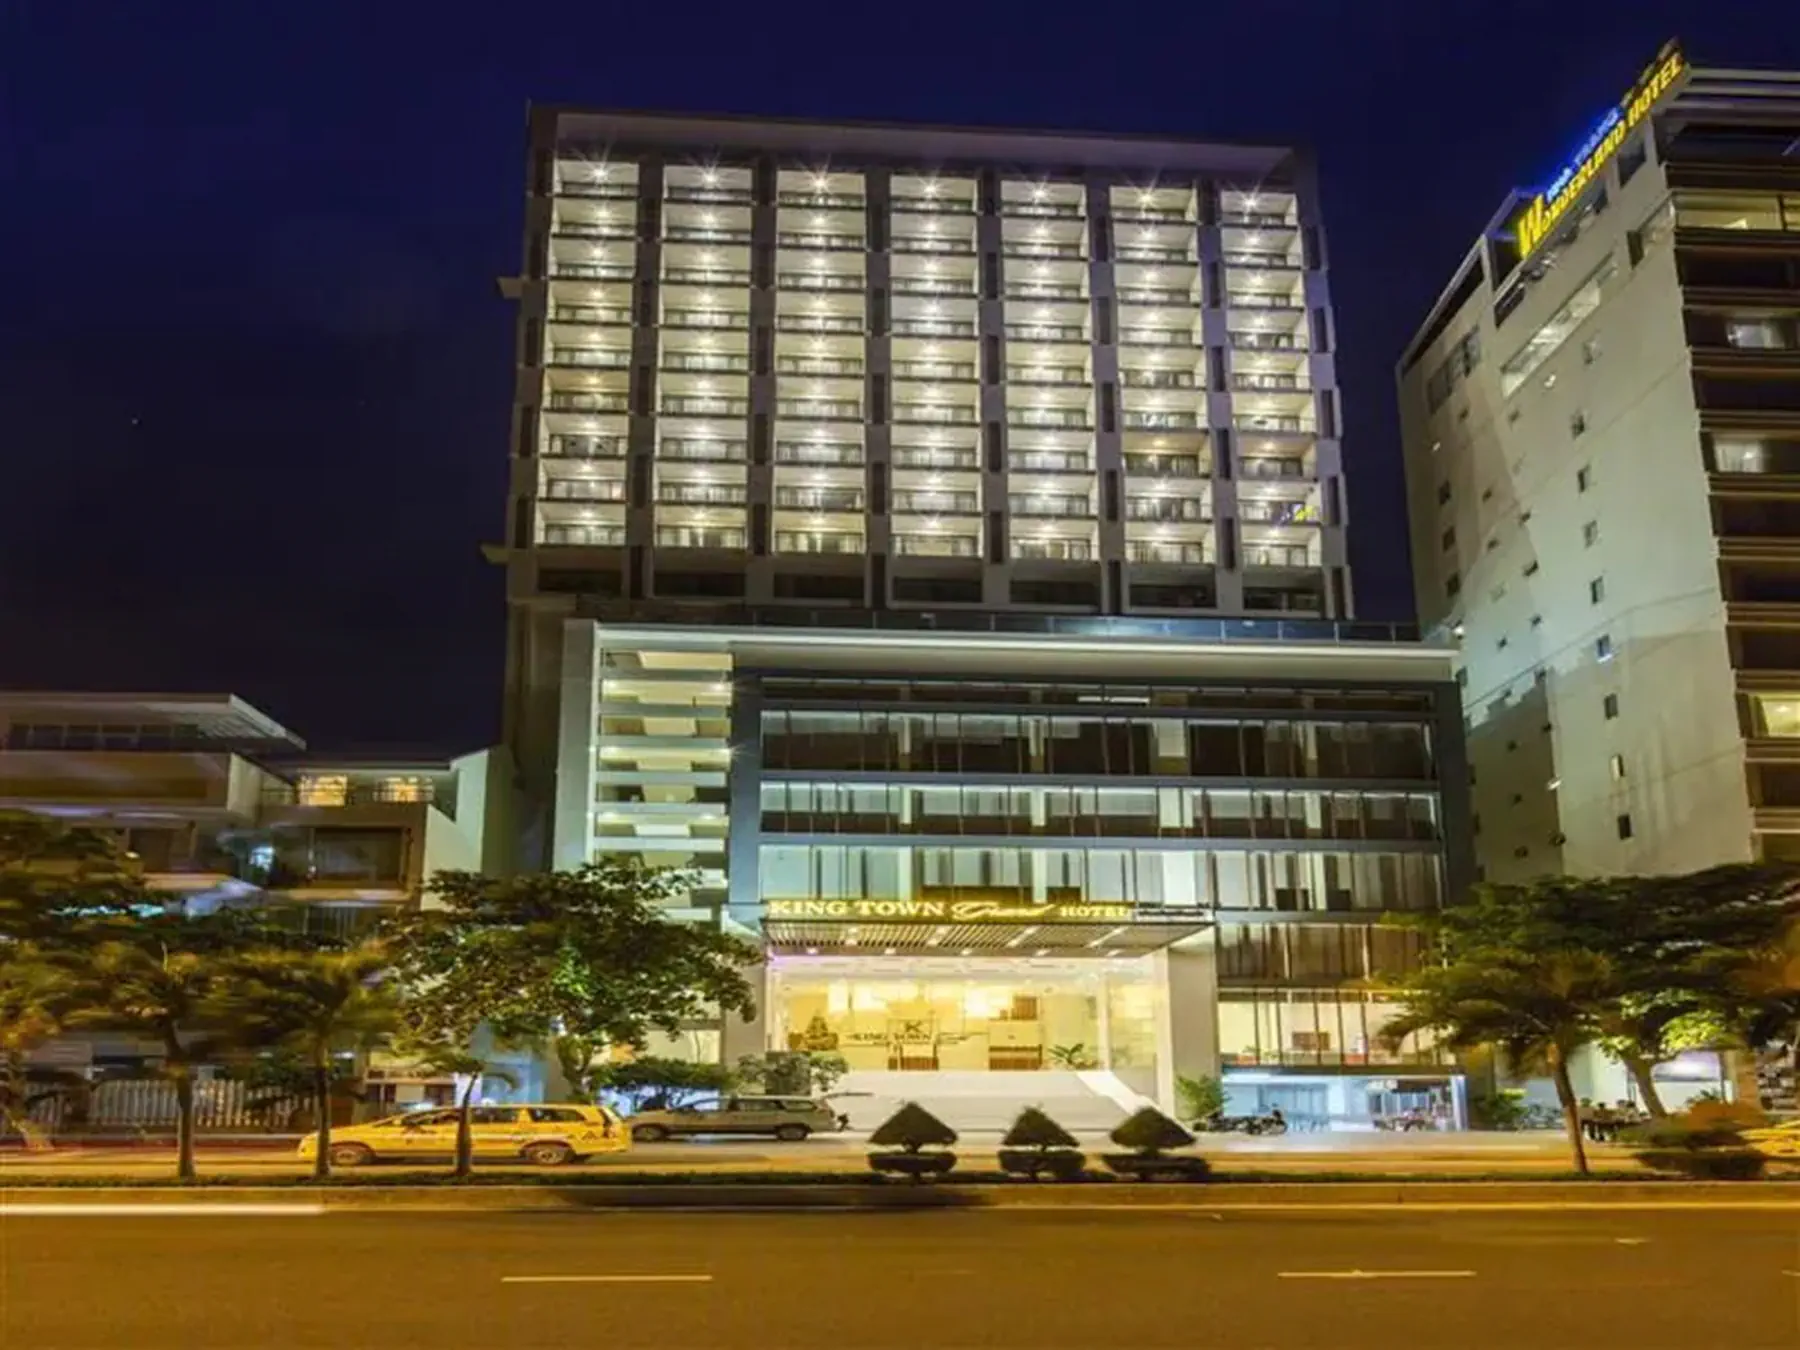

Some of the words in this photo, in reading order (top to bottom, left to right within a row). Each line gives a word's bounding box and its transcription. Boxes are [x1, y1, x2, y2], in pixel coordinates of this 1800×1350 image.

[1628, 52, 1681, 127] HOTEL
[769, 900, 847, 916] KING
[855, 901, 944, 917] TOWN
[1059, 904, 1131, 918] HOTEL
